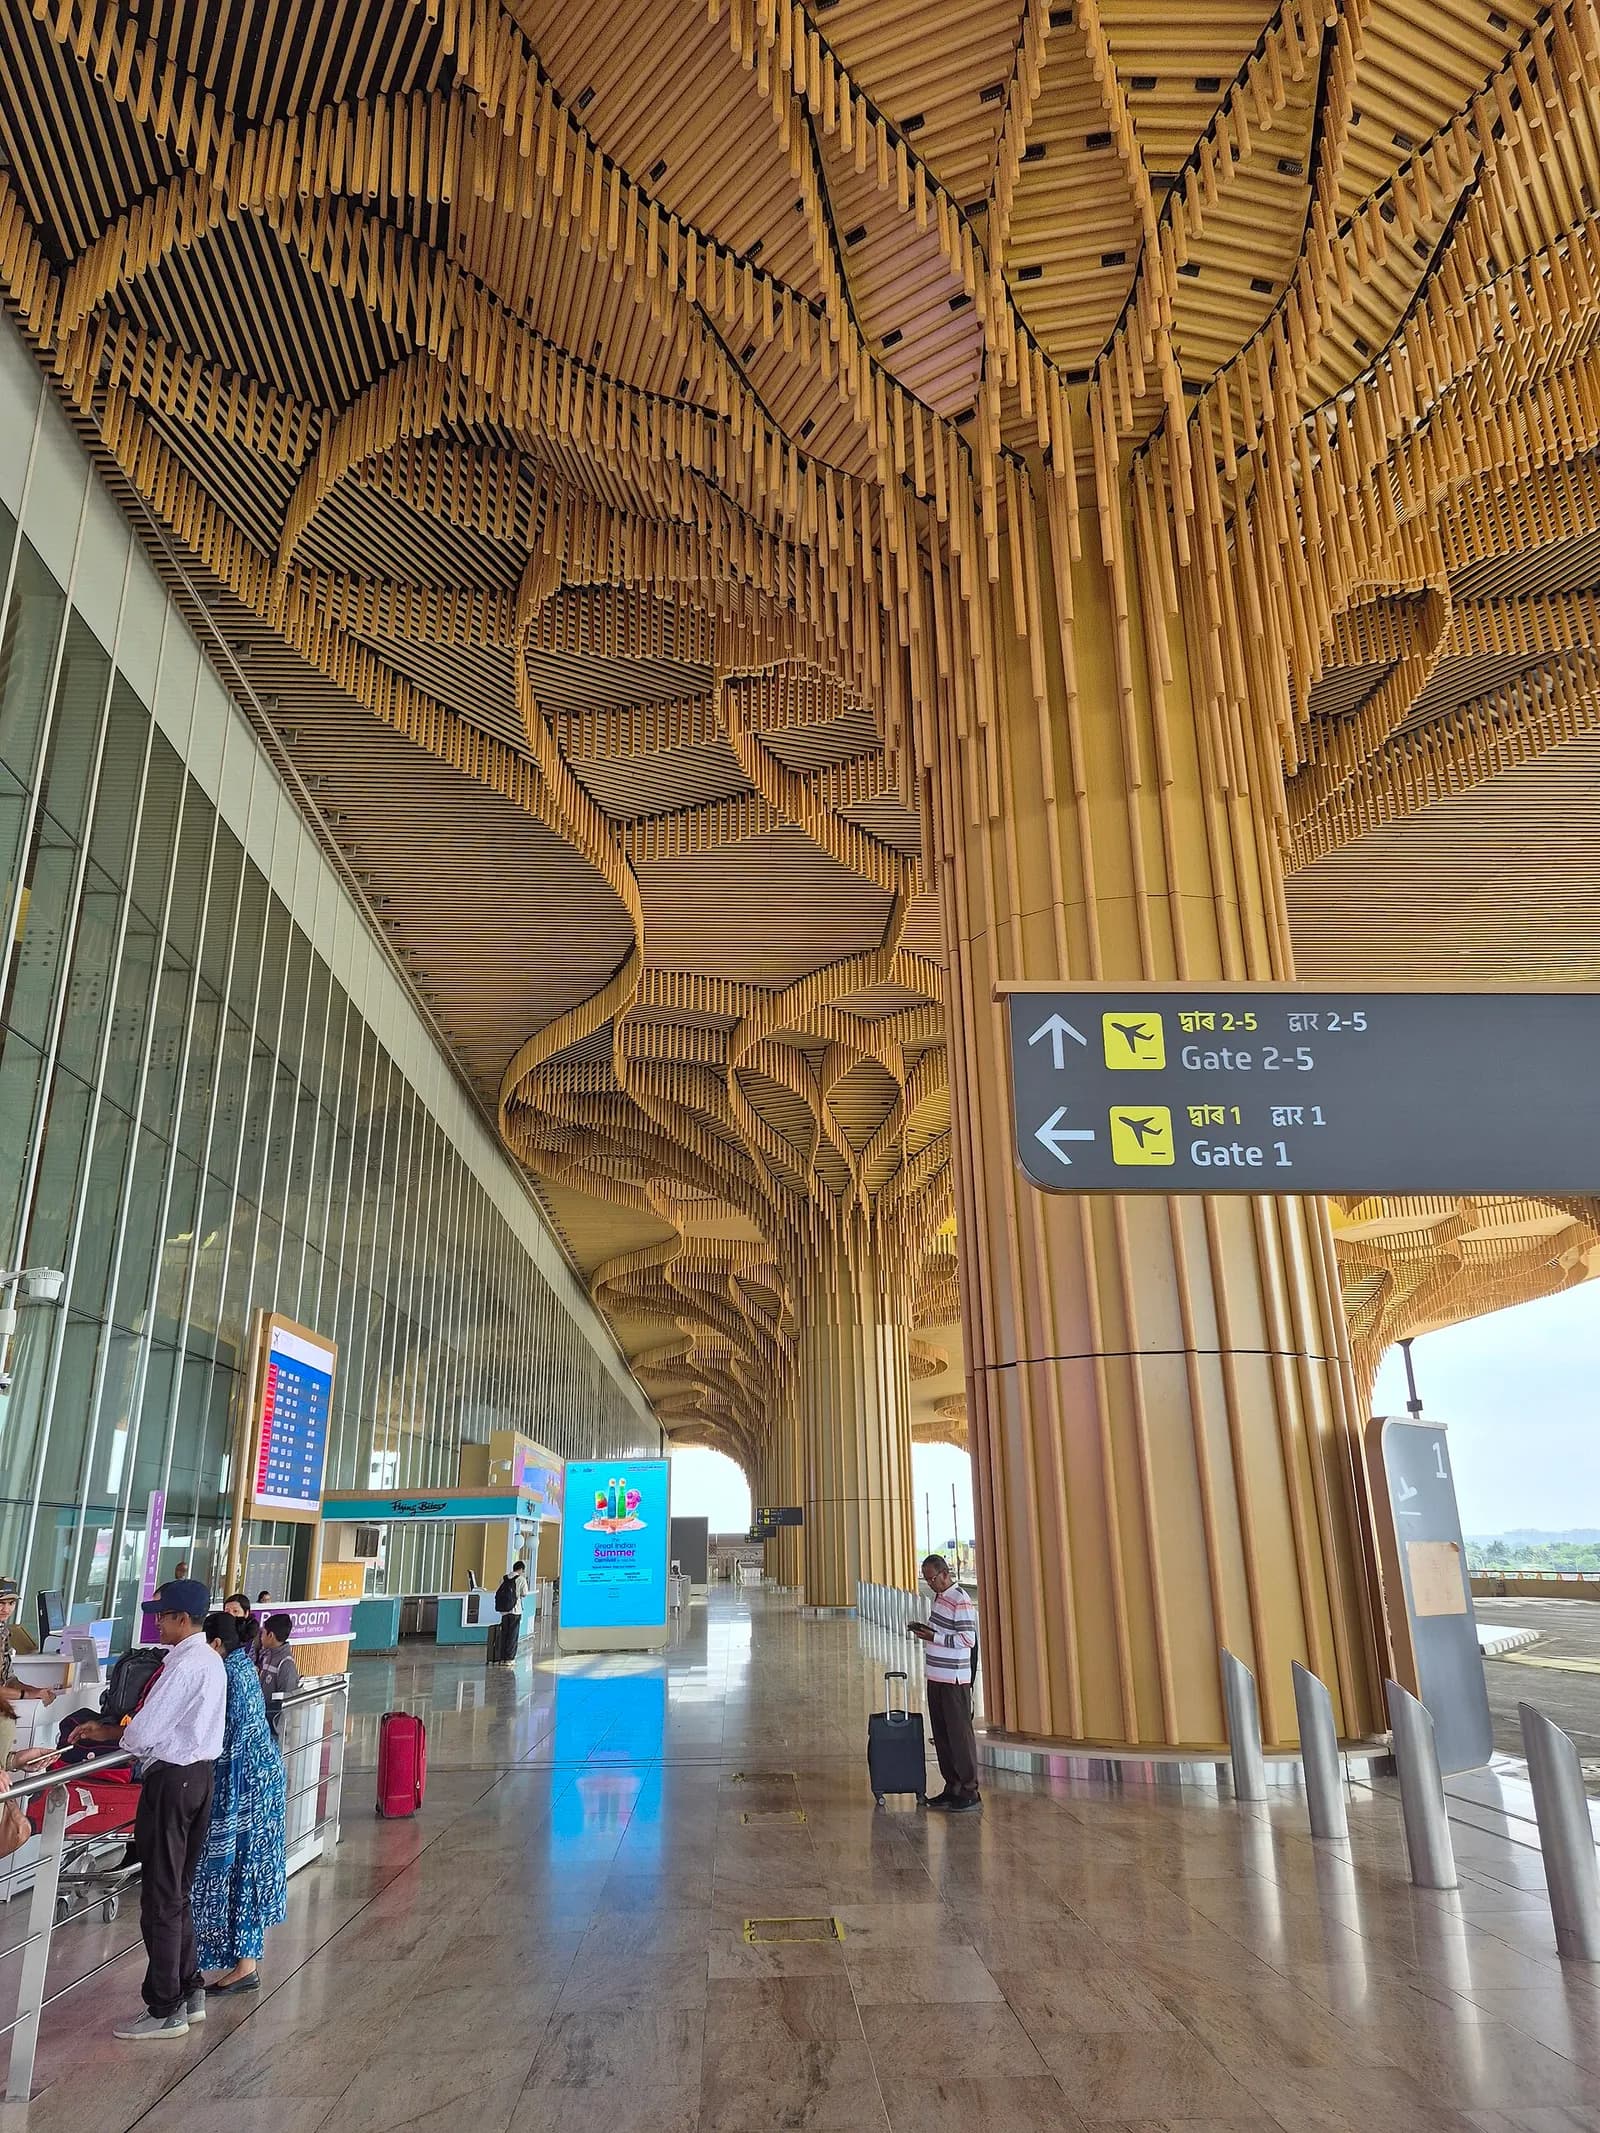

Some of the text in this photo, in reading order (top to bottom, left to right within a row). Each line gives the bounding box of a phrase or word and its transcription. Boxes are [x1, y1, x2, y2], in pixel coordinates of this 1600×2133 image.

[1221, 1012, 1258, 1031] 2-5
[1287, 1012, 1368, 1032] द्वार 2-5
[1181, 1045, 1314, 1071] Gate 2-5
[1230, 1106, 1241, 1125] 1
[1270, 1105, 1326, 1127] द्वार 1
[1190, 1140, 1293, 1167] Gate 1
[1432, 1442, 1448, 1479] 1
[594, 1549, 636, 1557] Summer
[259, 1611, 330, 1628] Pnaam
